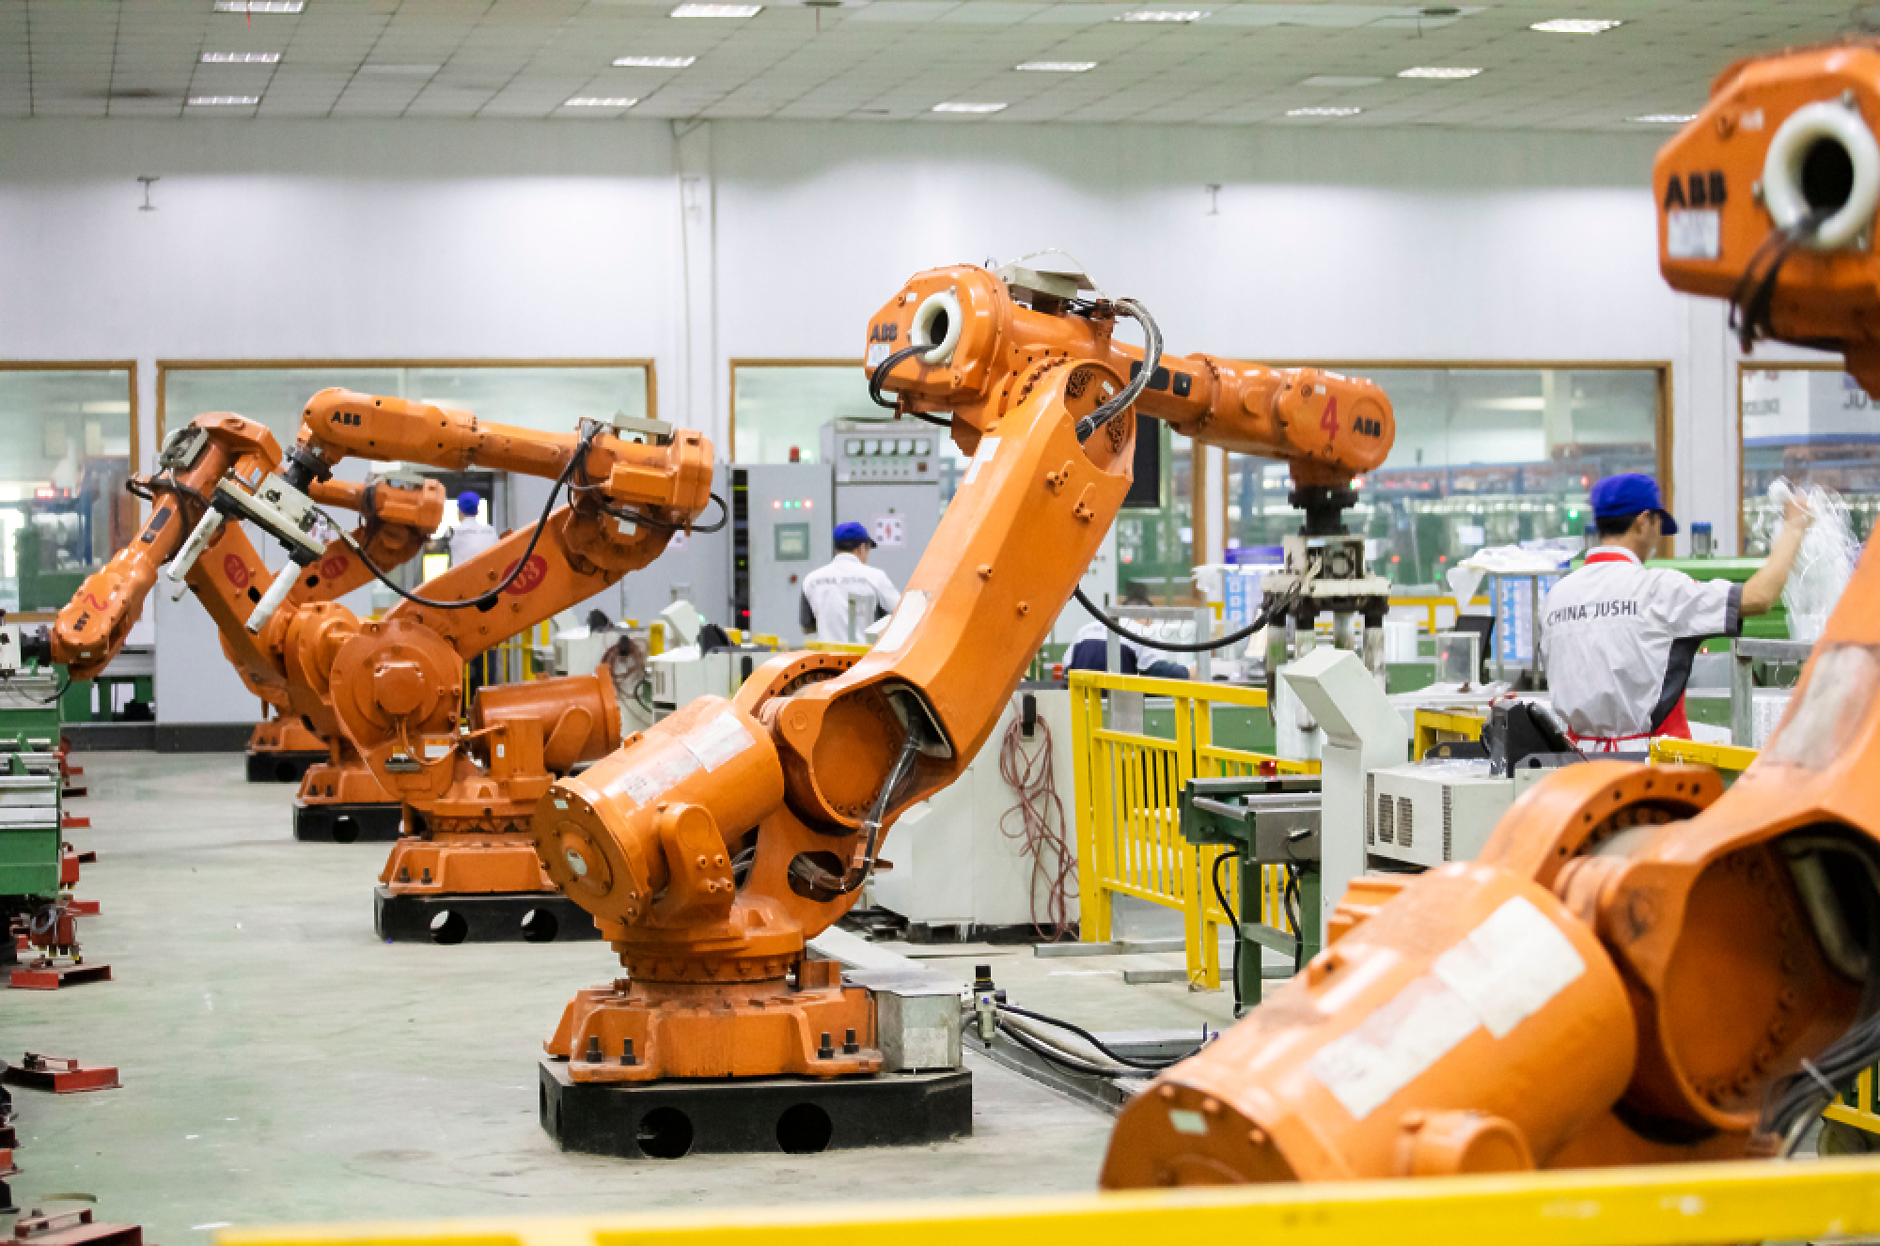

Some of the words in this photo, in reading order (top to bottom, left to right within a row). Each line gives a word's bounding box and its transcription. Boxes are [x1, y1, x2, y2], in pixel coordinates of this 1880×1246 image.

[1663, 170, 1727, 211] ABB
[869, 322, 898, 342] ABB
[330, 411, 362, 427] ABB
[1321, 395, 1339, 441] 4
[1352, 415, 1382, 438] ABB
[1547, 604, 1587, 626] CHINA
[1594, 599, 1637, 618] JUSHI
